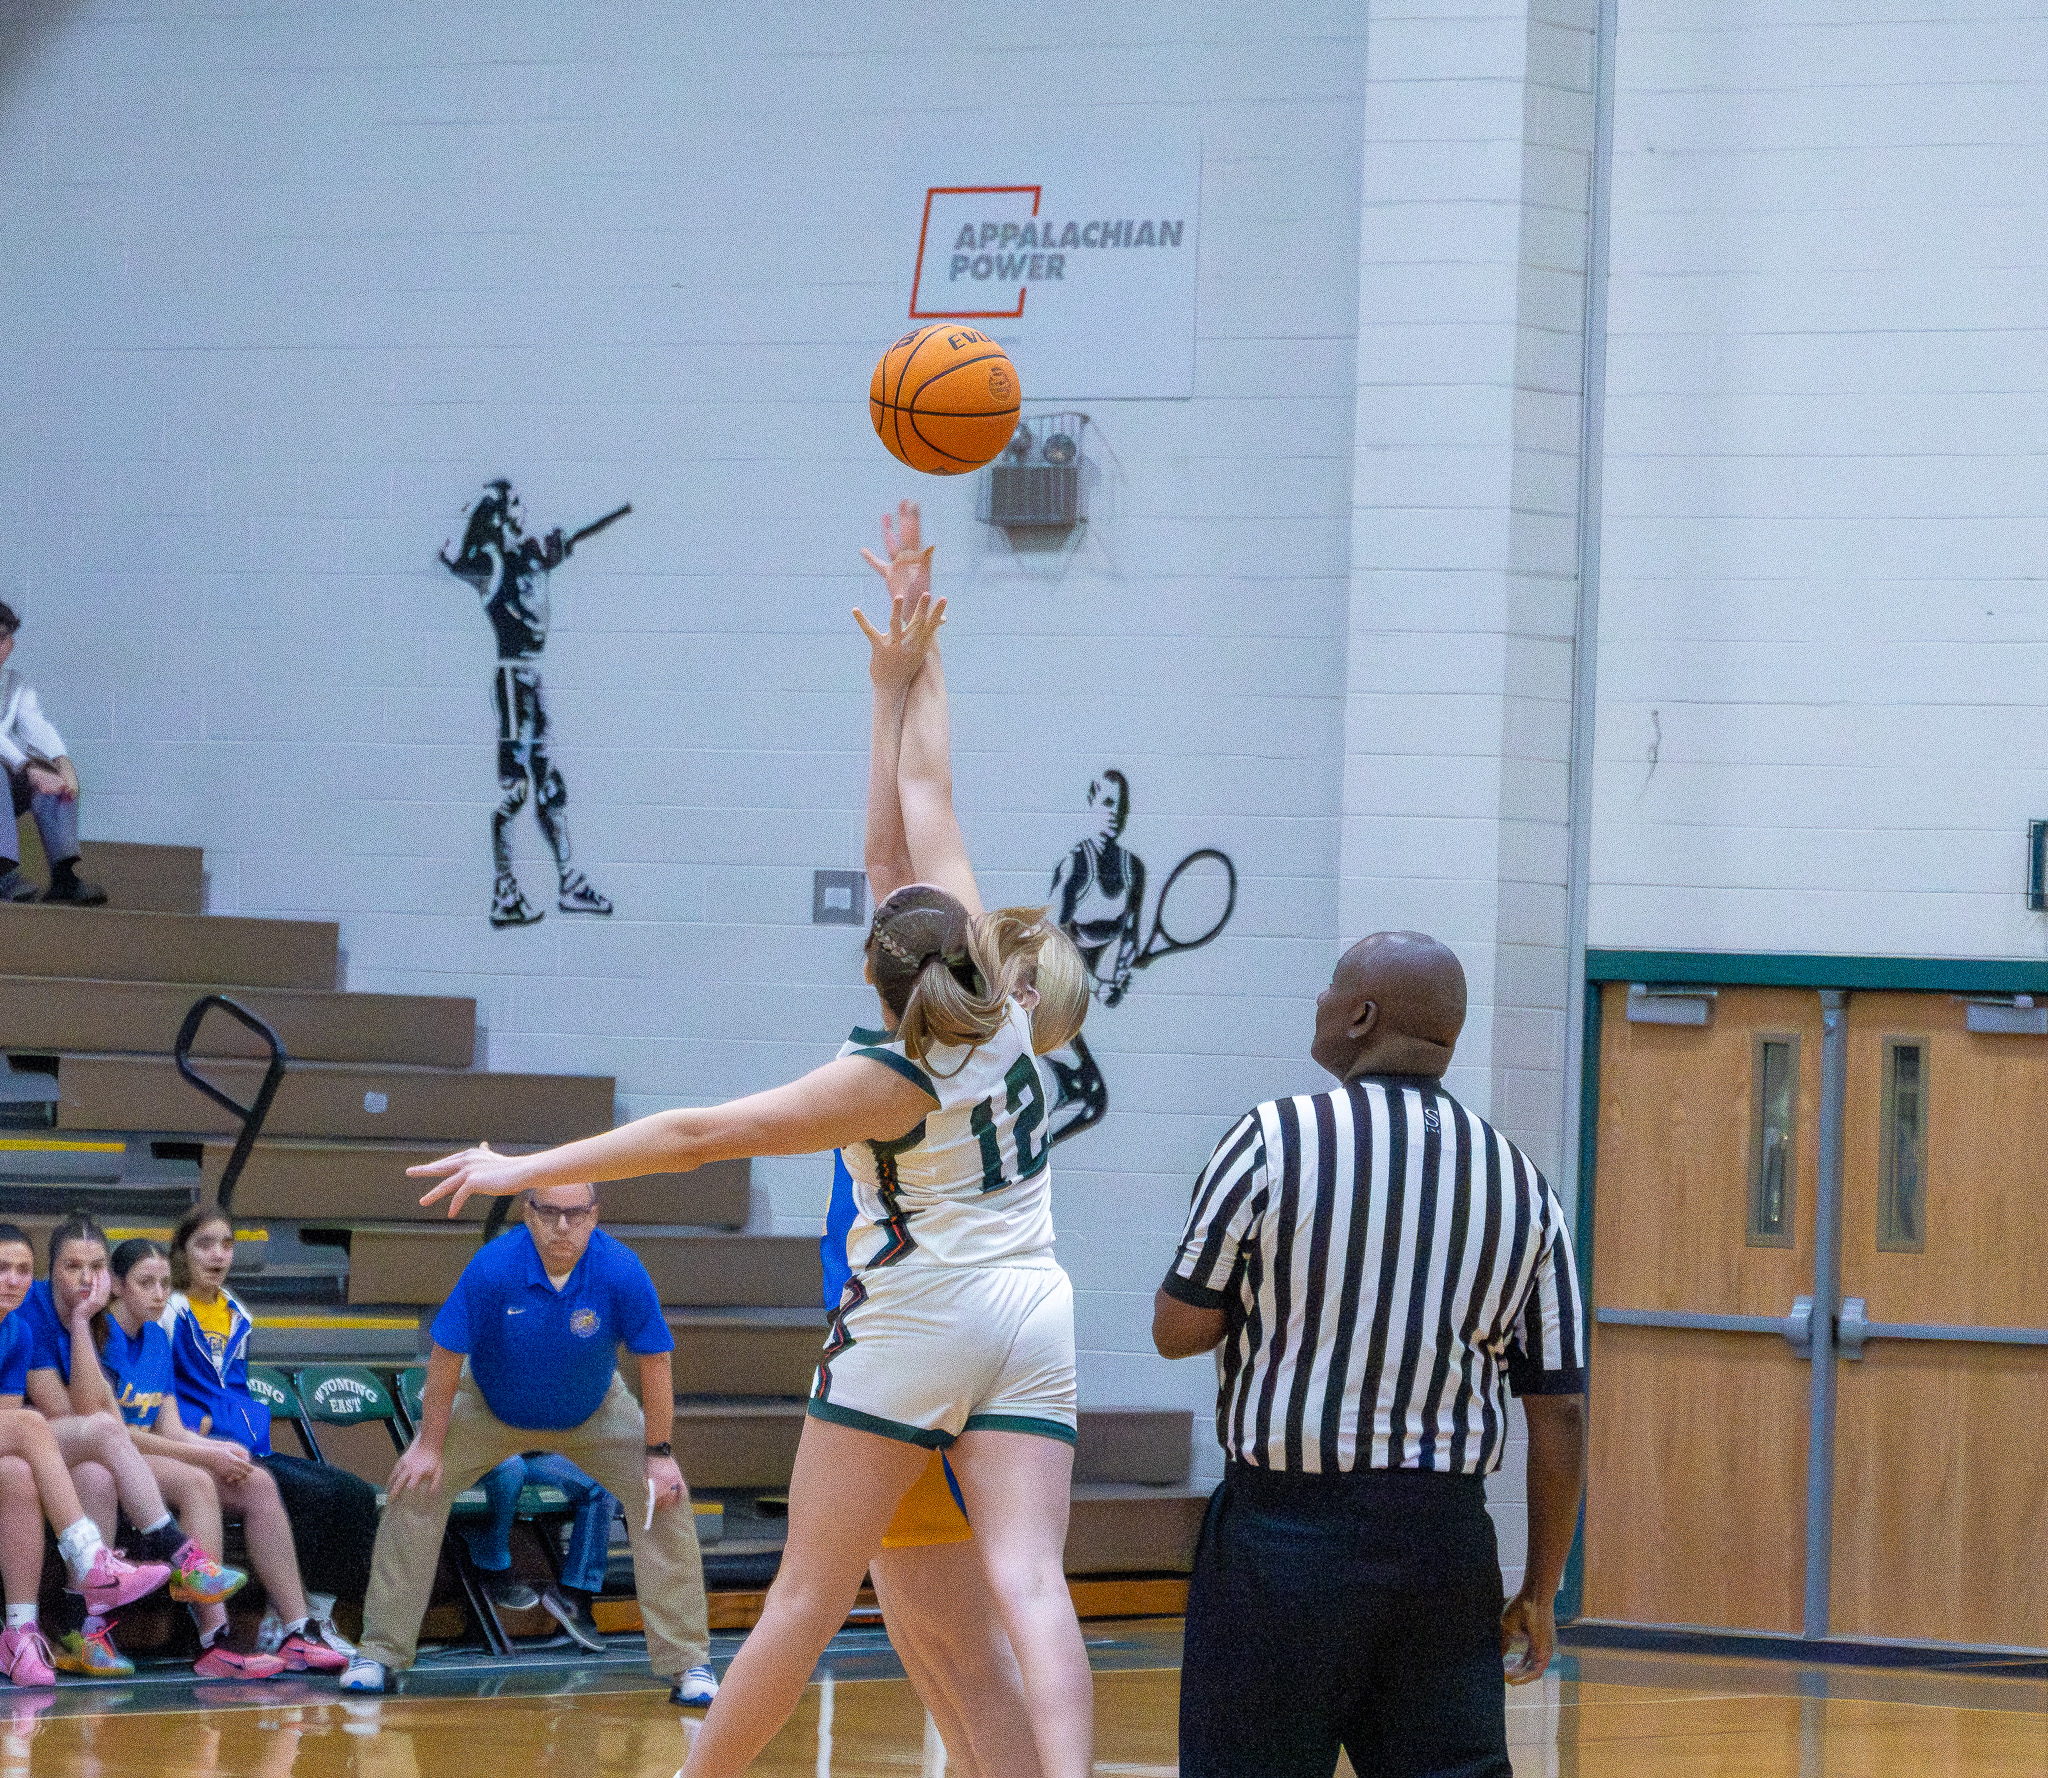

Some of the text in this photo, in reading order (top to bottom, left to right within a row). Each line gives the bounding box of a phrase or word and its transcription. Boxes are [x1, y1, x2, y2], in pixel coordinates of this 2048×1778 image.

[953, 219, 1184, 250] APPALACHIAN
[949, 252, 1066, 282] POWER
[969, 1052, 1049, 1194] 12
[314, 1377, 379, 1405] WYOMING
[329, 1398, 362, 1414] EAST
